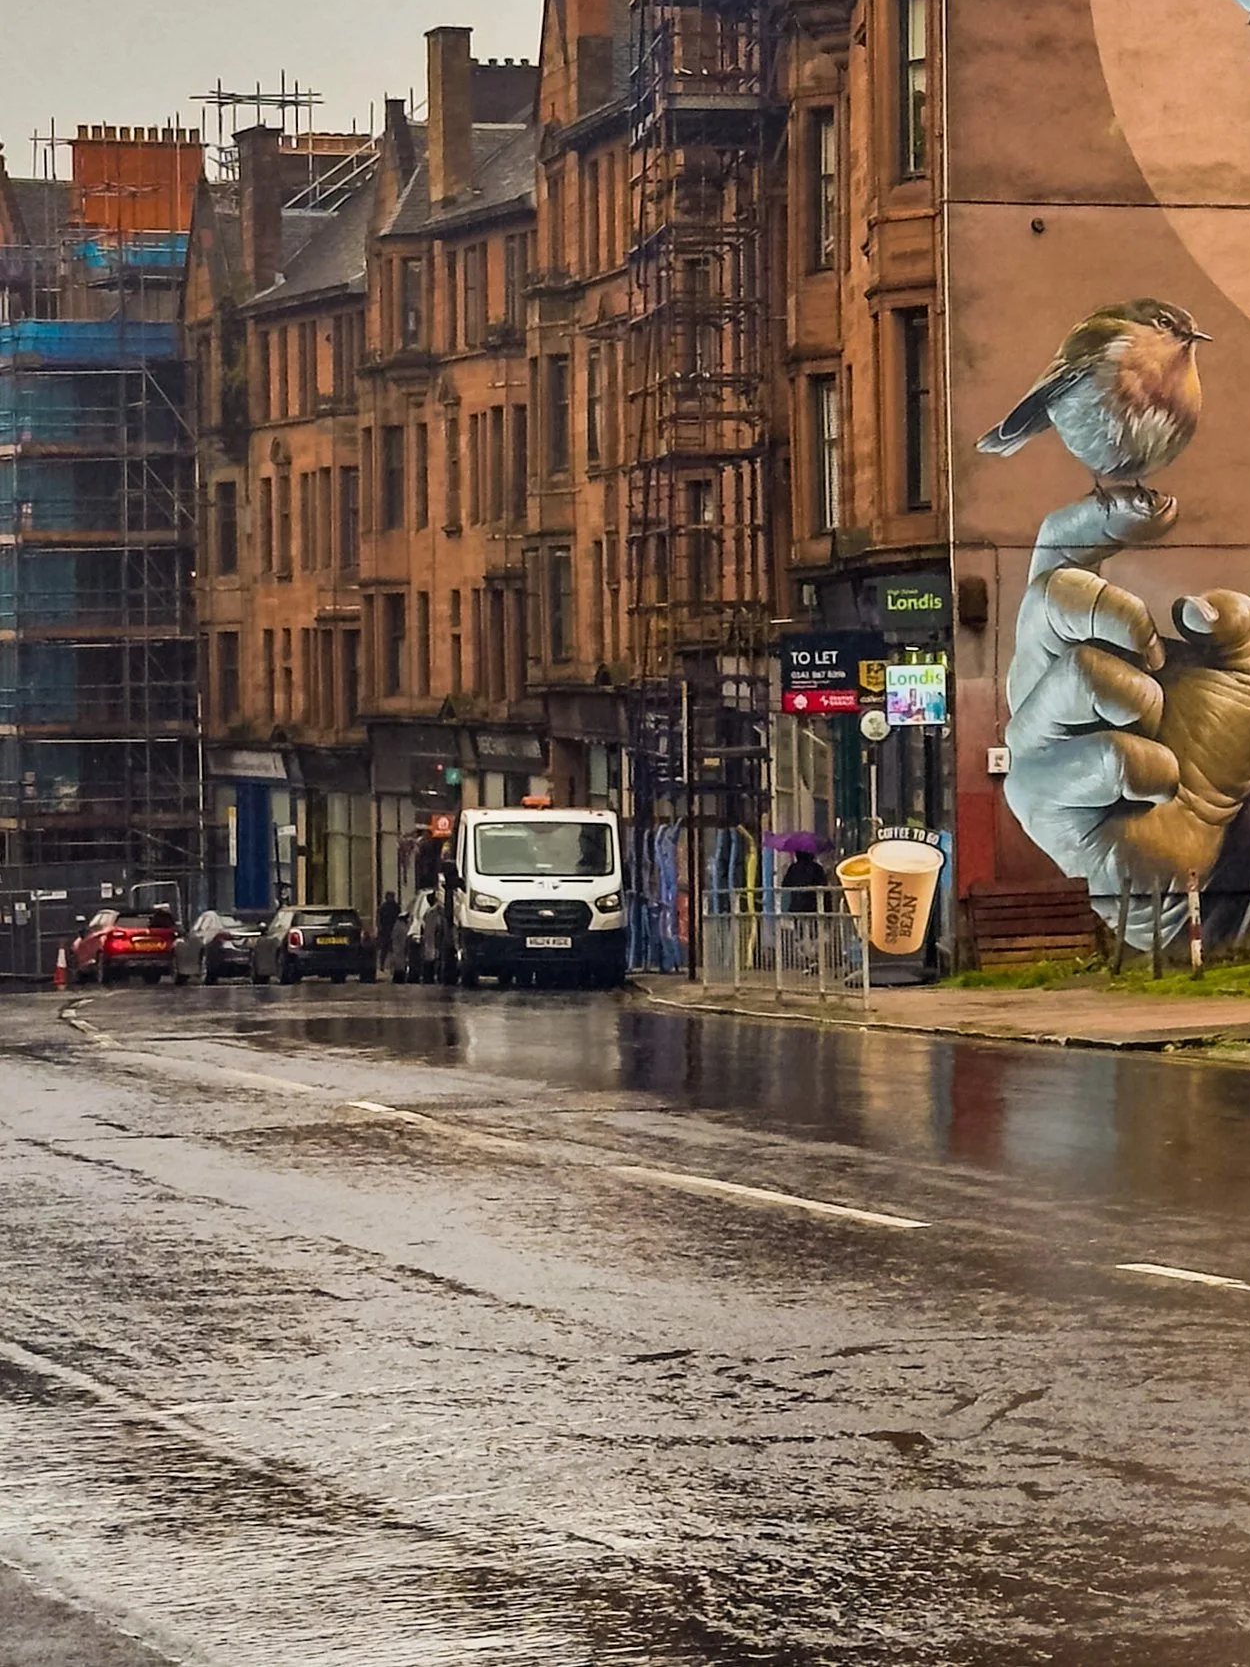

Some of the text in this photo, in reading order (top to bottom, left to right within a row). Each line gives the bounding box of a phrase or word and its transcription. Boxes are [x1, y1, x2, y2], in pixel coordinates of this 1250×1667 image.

[887, 593, 943, 611] Londis
[790, 650, 839, 665] TO LET
[888, 670, 943, 686] Londis
[877, 826, 911, 841] COFFEE
[913, 828, 926, 841] TO
[900, 894, 918, 938] BEAN
